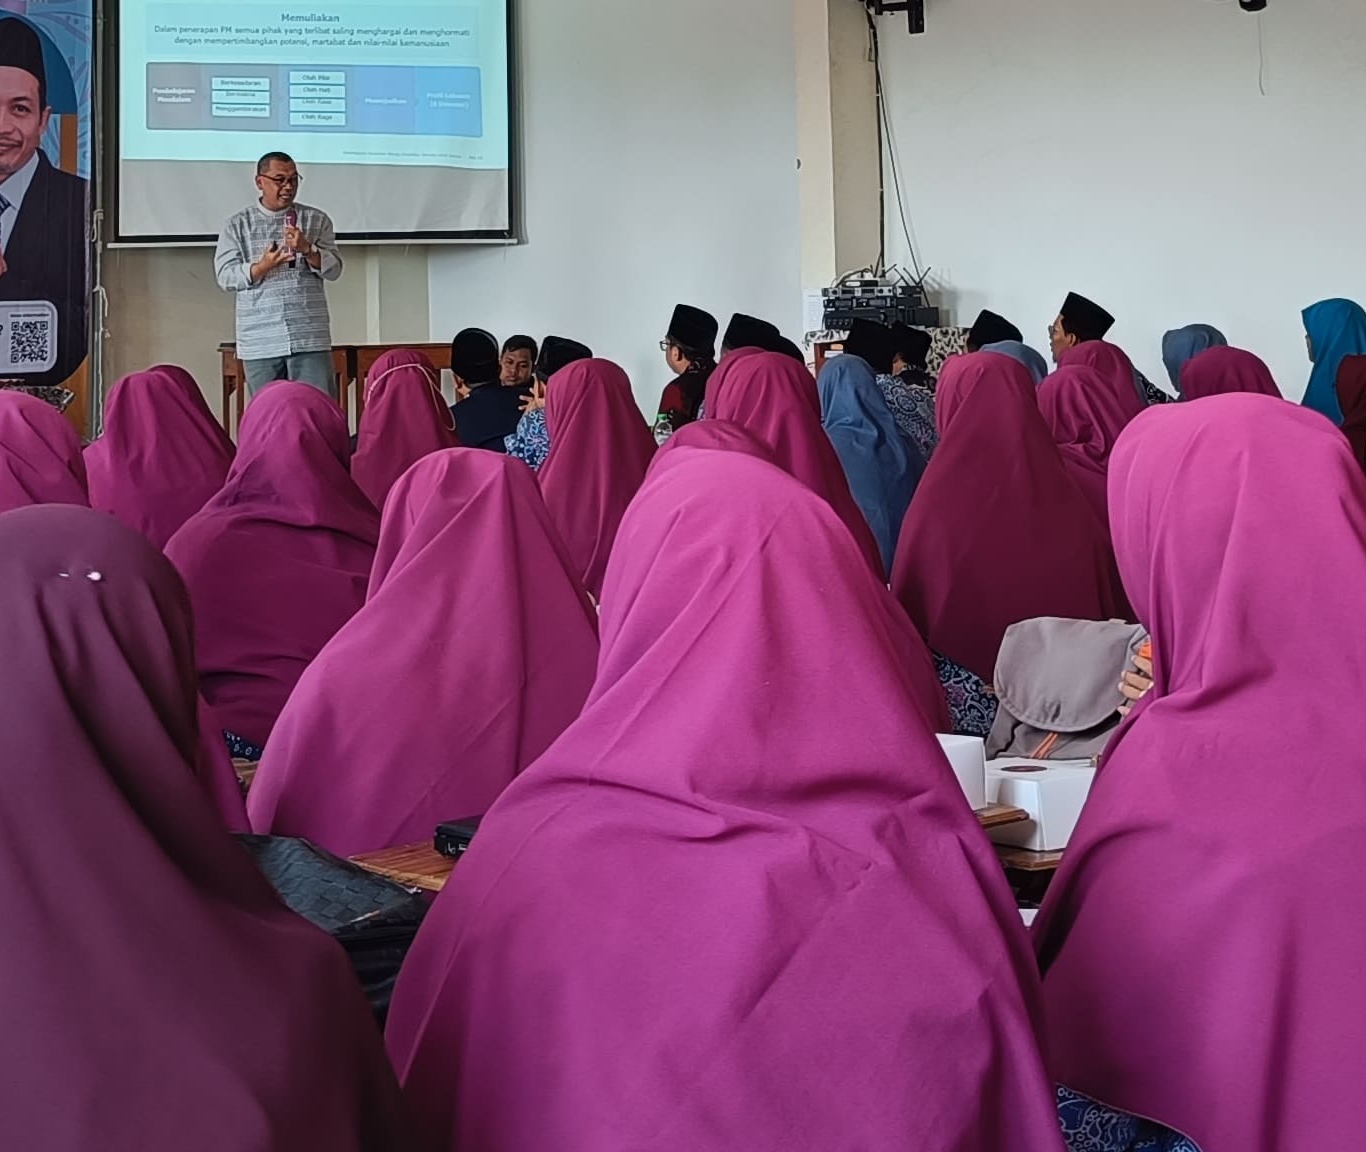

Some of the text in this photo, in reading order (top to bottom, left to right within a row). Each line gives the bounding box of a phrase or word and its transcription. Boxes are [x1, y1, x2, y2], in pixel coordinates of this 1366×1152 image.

[281, 13, 340, 22] Memuliakan
[154, 25, 178, 33] Dalam
[179, 26, 219, 35] penerapan
[174, 36, 202, 45] dengan
